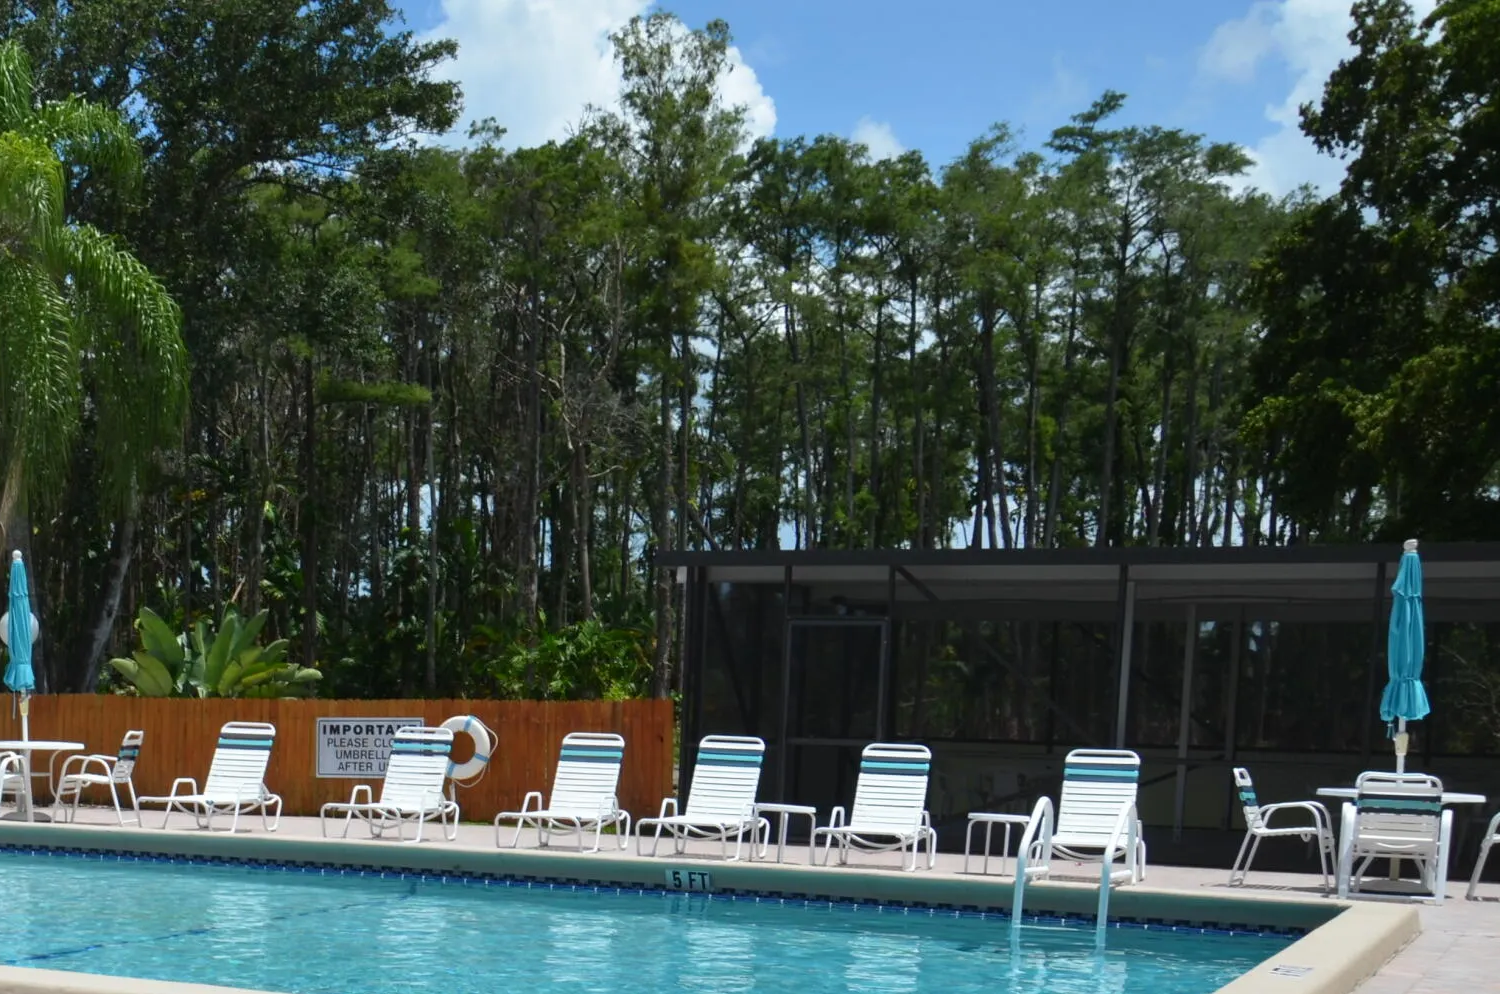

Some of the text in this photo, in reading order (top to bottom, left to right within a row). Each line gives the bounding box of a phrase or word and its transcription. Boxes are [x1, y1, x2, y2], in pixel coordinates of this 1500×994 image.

[327, 738, 368, 748] PLEASE
[337, 762, 373, 772] AFTER
[672, 870, 708, 890] 5 FT
